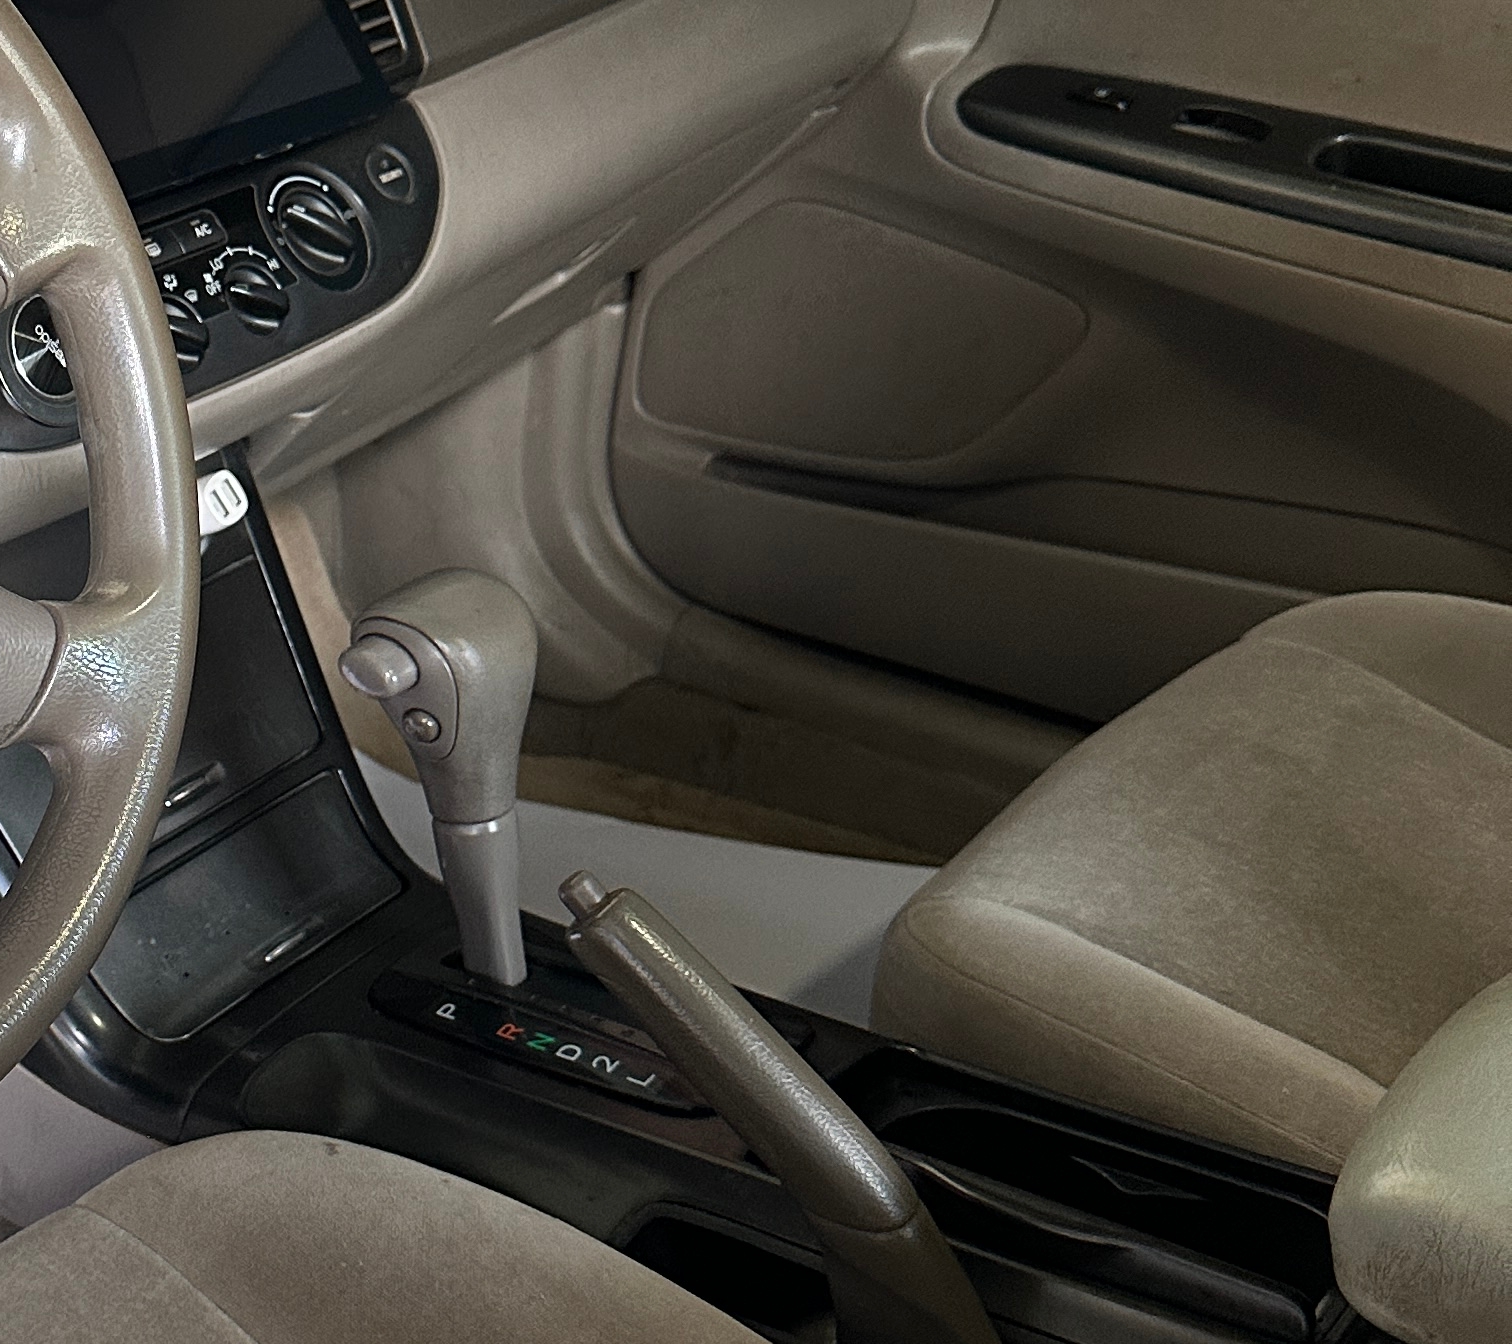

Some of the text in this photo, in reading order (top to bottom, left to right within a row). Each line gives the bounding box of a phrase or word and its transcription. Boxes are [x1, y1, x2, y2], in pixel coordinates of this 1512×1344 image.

[436, 1003, 657, 1088] P R N D 2 L
